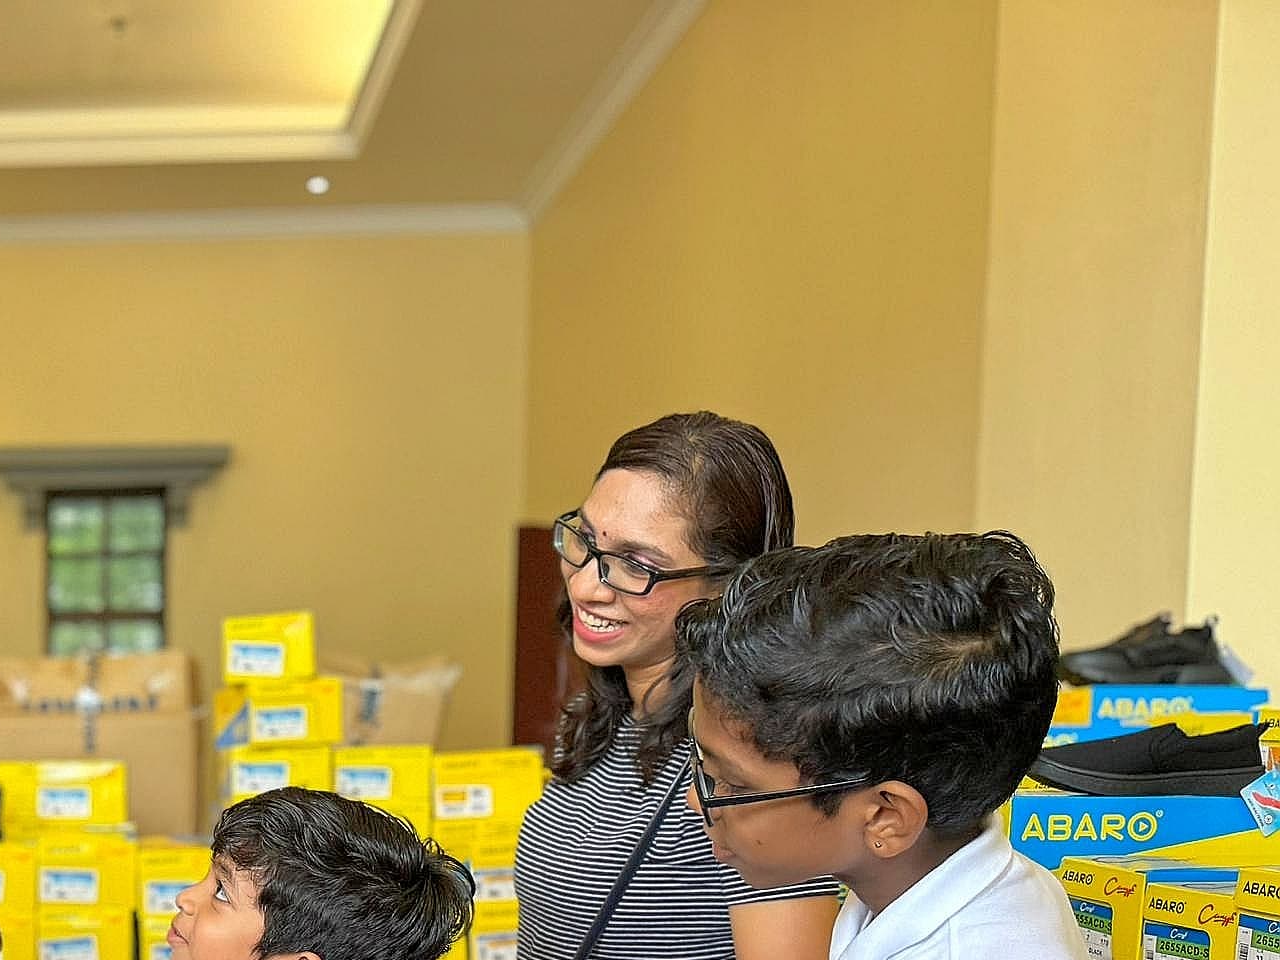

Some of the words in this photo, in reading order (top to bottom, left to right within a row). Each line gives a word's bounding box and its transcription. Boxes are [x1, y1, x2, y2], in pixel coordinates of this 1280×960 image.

[1021, 811, 1158, 842] ABARO
[1062, 870, 1093, 886] ABARO
[1243, 880, 1280, 900] ABAR
[1149, 897, 1185, 914] ABARO
[1160, 940, 1209, 958] 2655ACD-S
